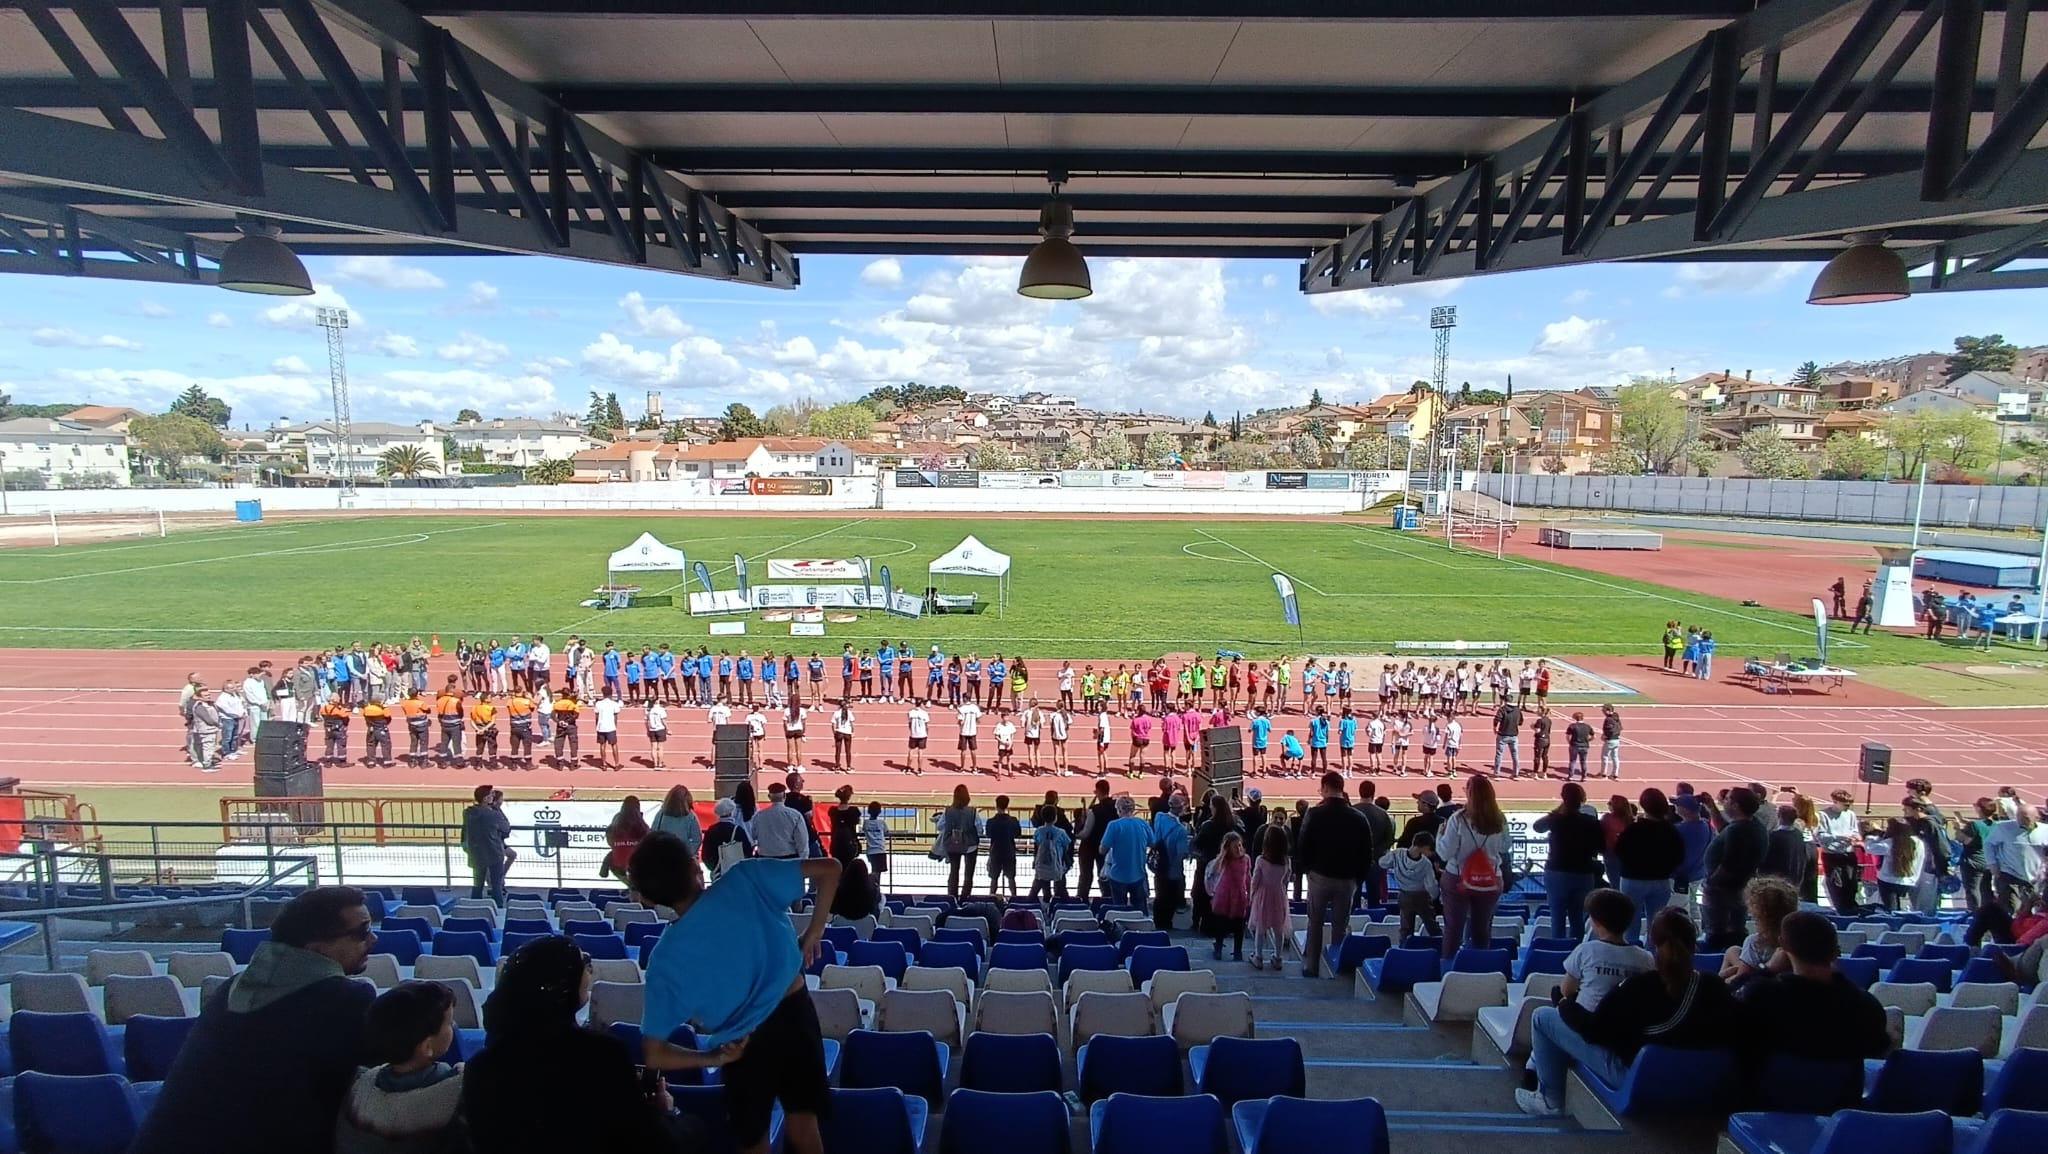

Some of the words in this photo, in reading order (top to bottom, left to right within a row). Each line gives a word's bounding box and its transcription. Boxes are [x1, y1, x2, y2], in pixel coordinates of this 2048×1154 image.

[567, 834, 585, 842] DEL
[587, 834, 606, 842] REY
[1531, 846, 1549, 854] DEL
